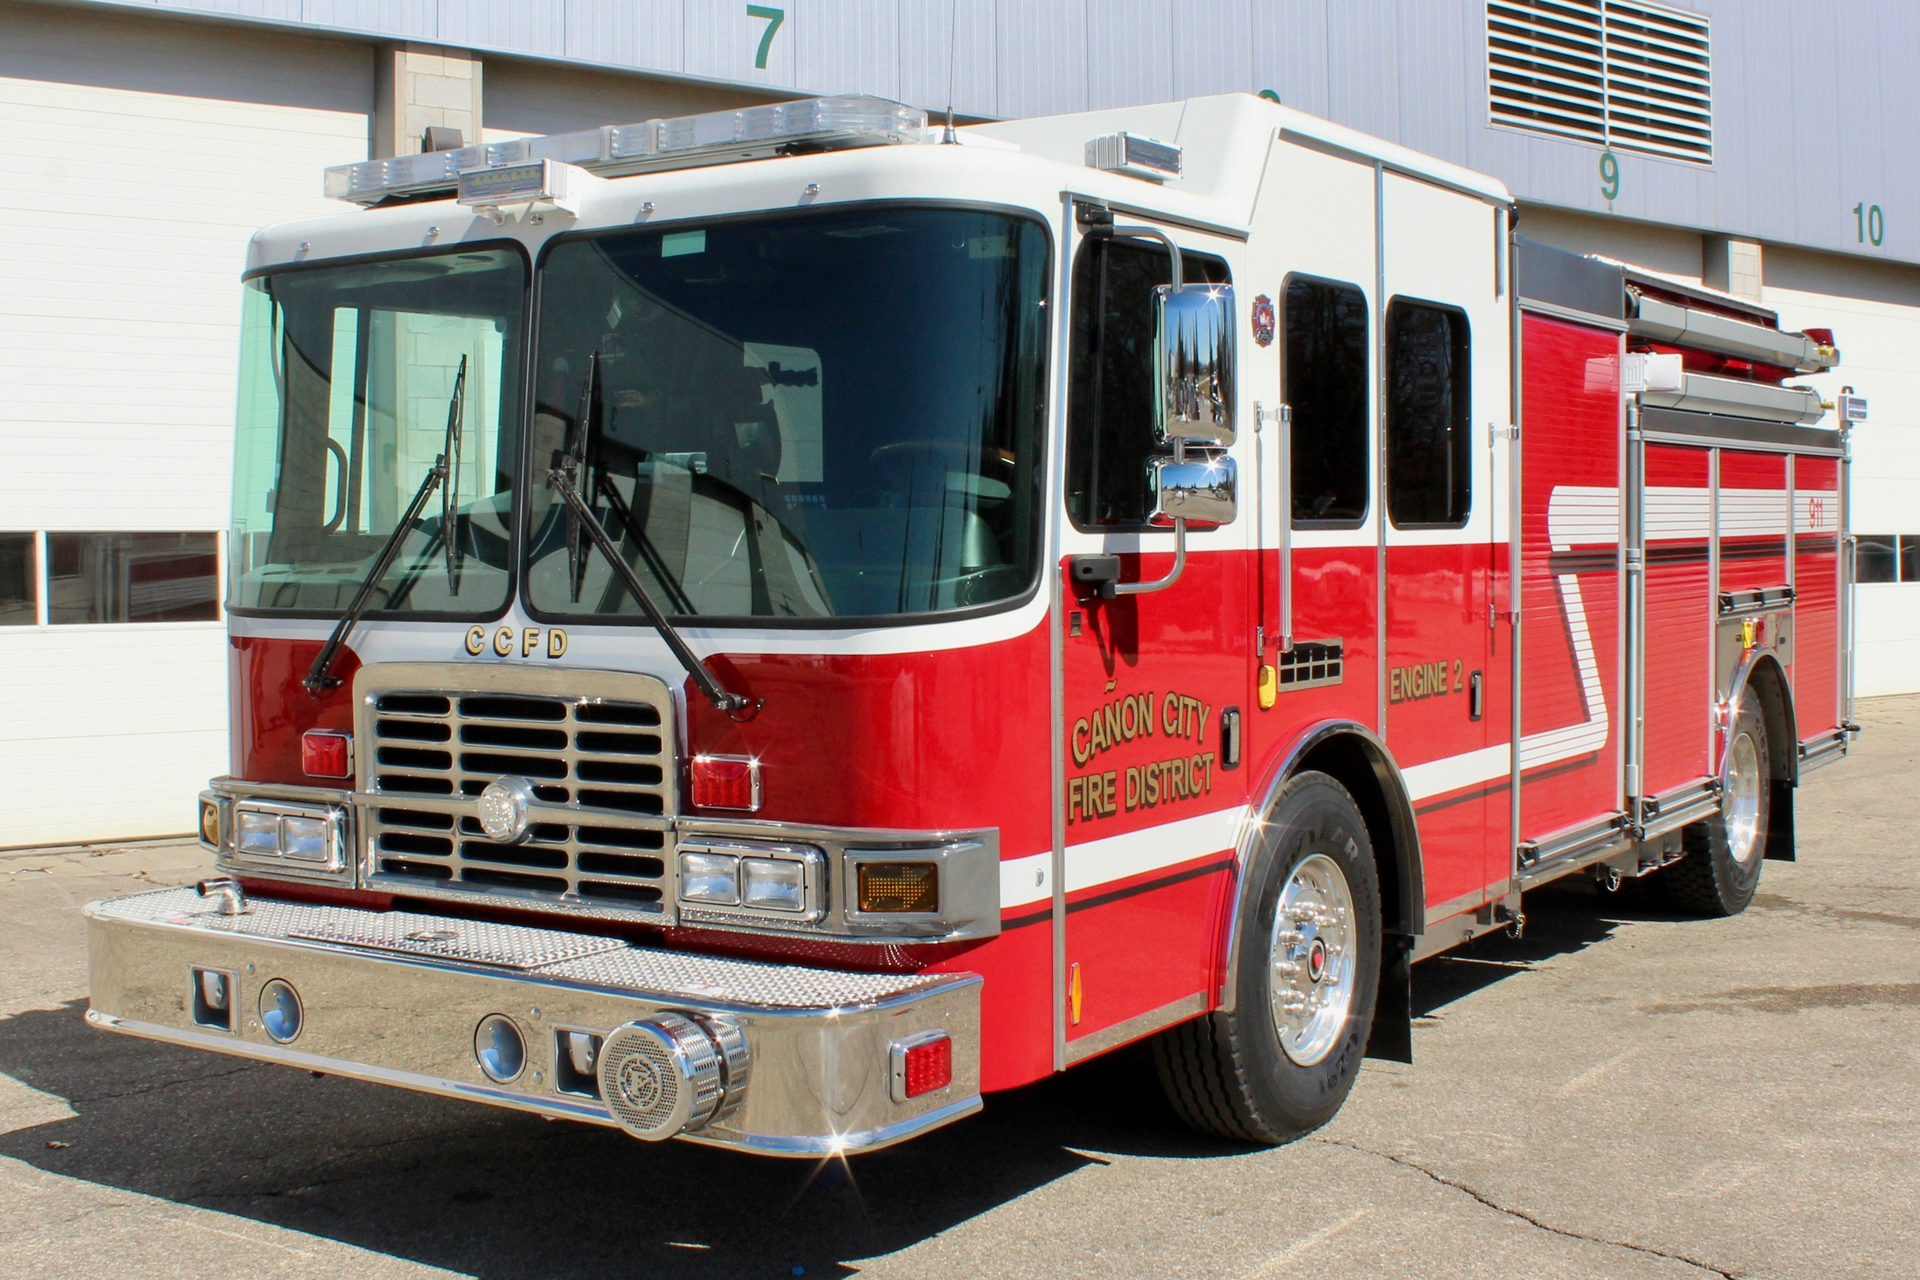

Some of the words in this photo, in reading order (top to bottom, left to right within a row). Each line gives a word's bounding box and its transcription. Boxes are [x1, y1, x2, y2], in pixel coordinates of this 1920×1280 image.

[746, 4, 785, 70] 7
[1599, 152, 1620, 201] 9
[1852, 201, 1884, 247] 10
[1809, 497, 1823, 529] 911
[465, 624, 568, 659] CCFD
[1390, 660, 1448, 705] ENGINE
[1453, 658, 1463, 693] 2
[1161, 690, 1212, 744] CITY
[1068, 770, 1117, 825] FIRE
[1125, 752, 1215, 813] DISTRICT
